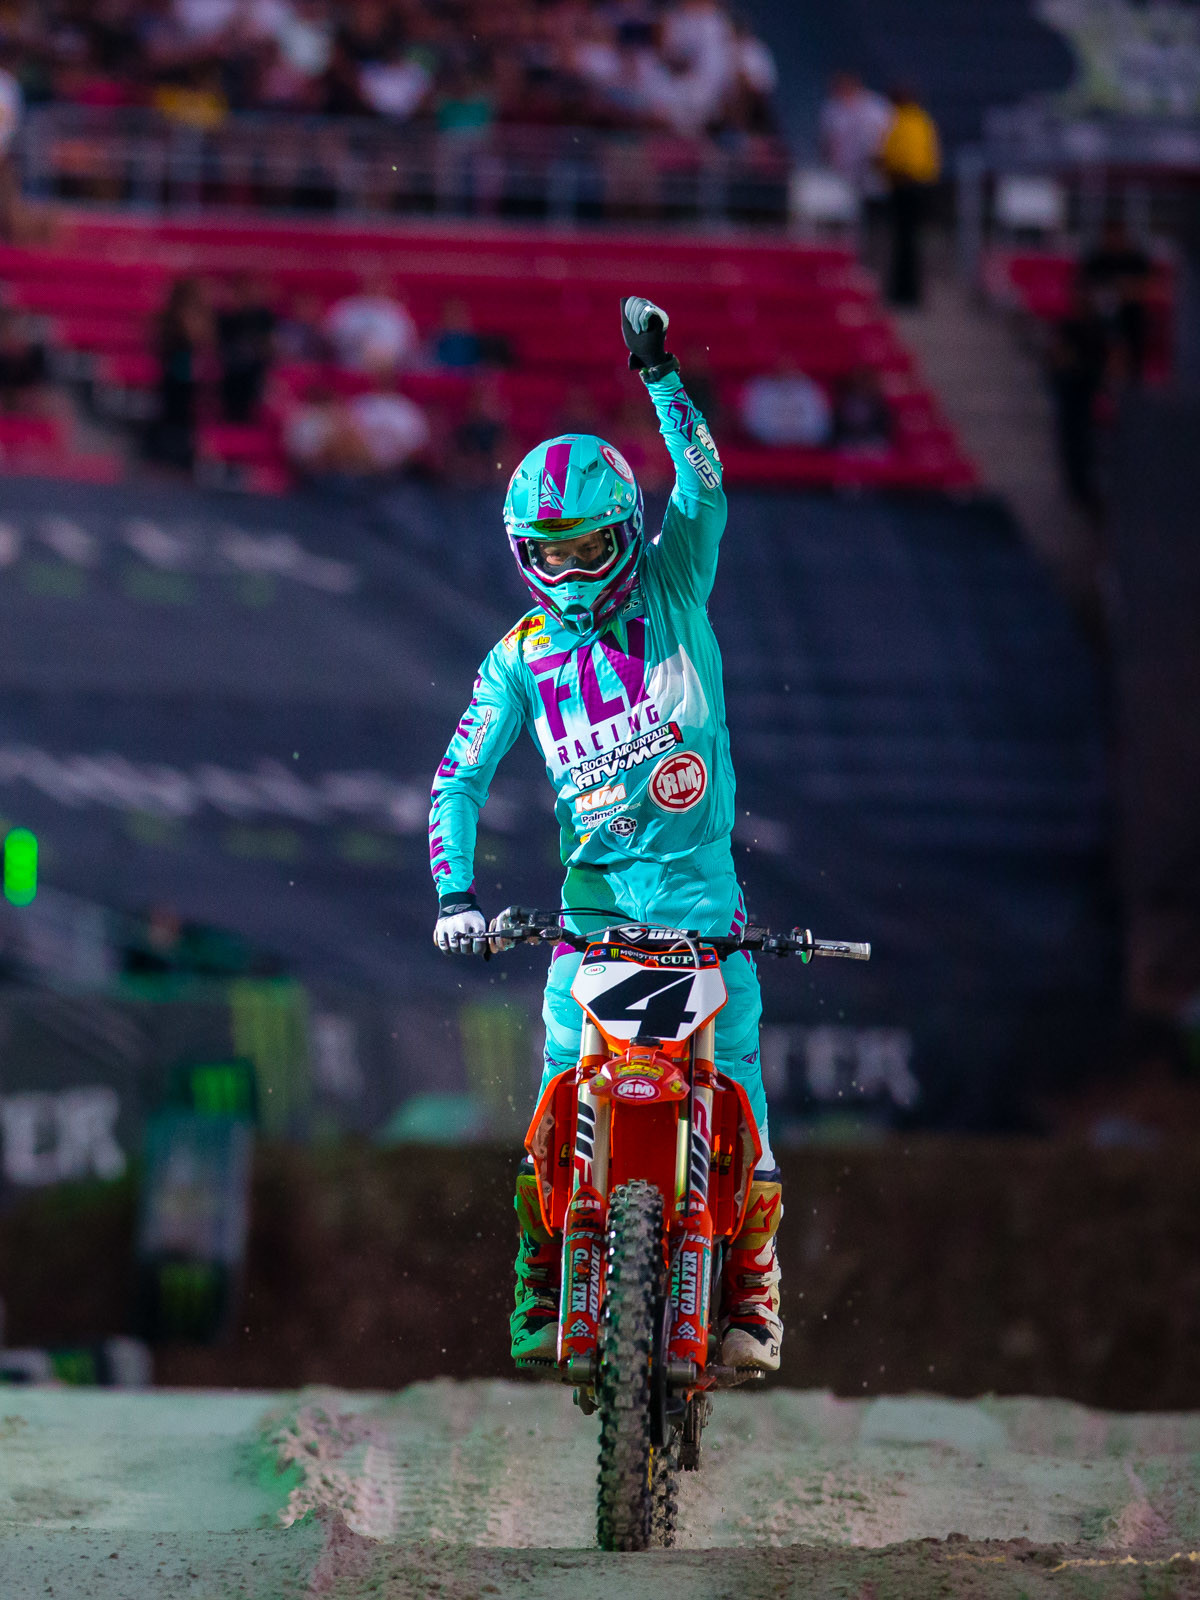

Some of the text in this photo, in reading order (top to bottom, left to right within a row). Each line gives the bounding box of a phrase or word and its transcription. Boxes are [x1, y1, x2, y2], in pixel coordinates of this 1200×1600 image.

[685, 445, 720, 489] WPS
[528, 615, 651, 742] FLY
[557, 704, 660, 766] RACING
[581, 725, 670, 774] ROCKY MOUNTAIN
[575, 783, 627, 813] KTM
[609, 820, 638, 831] GEAR
[661, 955, 694, 965] CUP
[587, 970, 697, 1039] 4
[571, 1199, 601, 1210] GEAR
[571, 1248, 589, 1312] GFER
[588, 1243, 601, 1323] DUNLOP
[680, 1250, 698, 1315] GALFER
